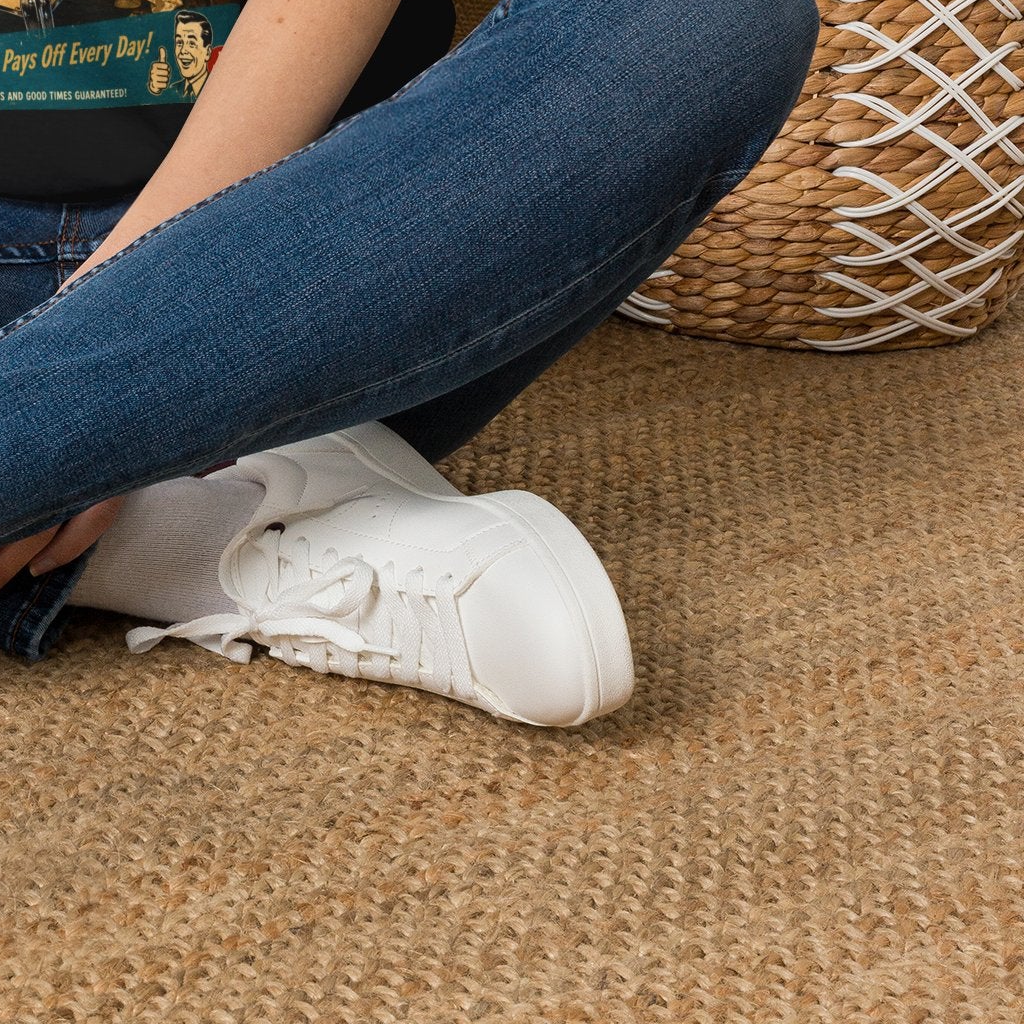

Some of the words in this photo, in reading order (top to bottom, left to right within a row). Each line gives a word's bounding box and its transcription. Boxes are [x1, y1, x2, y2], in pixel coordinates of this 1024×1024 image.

[2, 48, 37, 76] Pays
[41, 42, 67, 69] Off
[69, 41, 113, 67] Every
[116, 31, 154, 61] Day!
[7, 91, 23, 101] AND
[26, 91, 47, 101] GOOD
[49, 90, 72, 101] TIMES
[74, 88, 127, 100] GUARANTEED!
